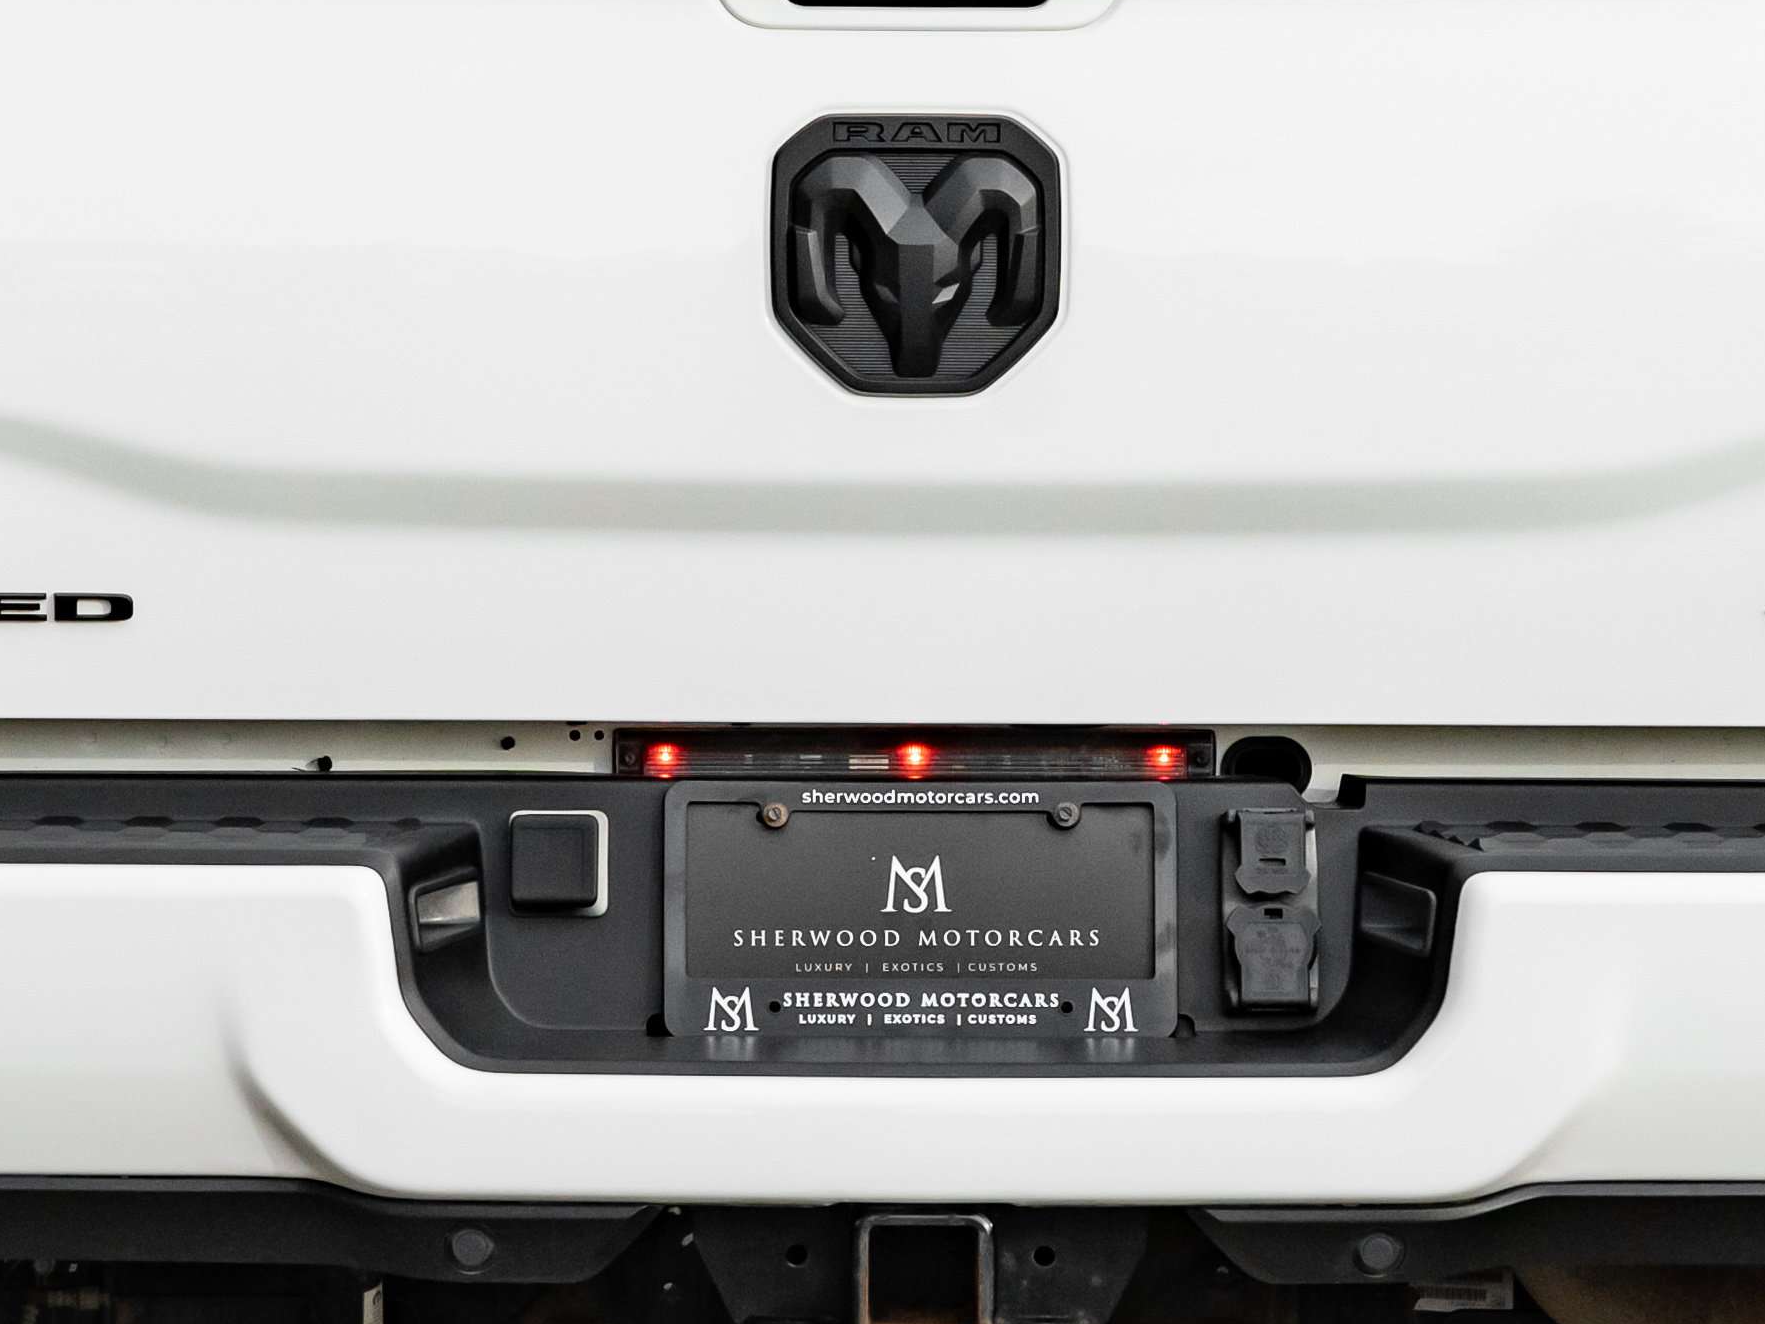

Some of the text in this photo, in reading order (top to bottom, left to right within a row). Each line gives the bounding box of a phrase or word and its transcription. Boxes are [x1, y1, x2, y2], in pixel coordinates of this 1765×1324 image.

[833, 122, 1001, 143] RAM
[801, 788, 1040, 805] sherwoodmotorcars.com
[733, 929, 1100, 947] SHERWOOD MOTORCARS
[795, 962, 853, 972] LUXURY
[882, 962, 944, 972] EXOTICS
[967, 962, 1038, 972] CUSTOMS
[782, 992, 1060, 1008] SHERWOOD MOTORCARS
[798, 1013, 856, 1025] LUXURY
[883, 1013, 946, 1025] EXOTICS
[967, 1013, 1037, 1025] CUSTOMS
